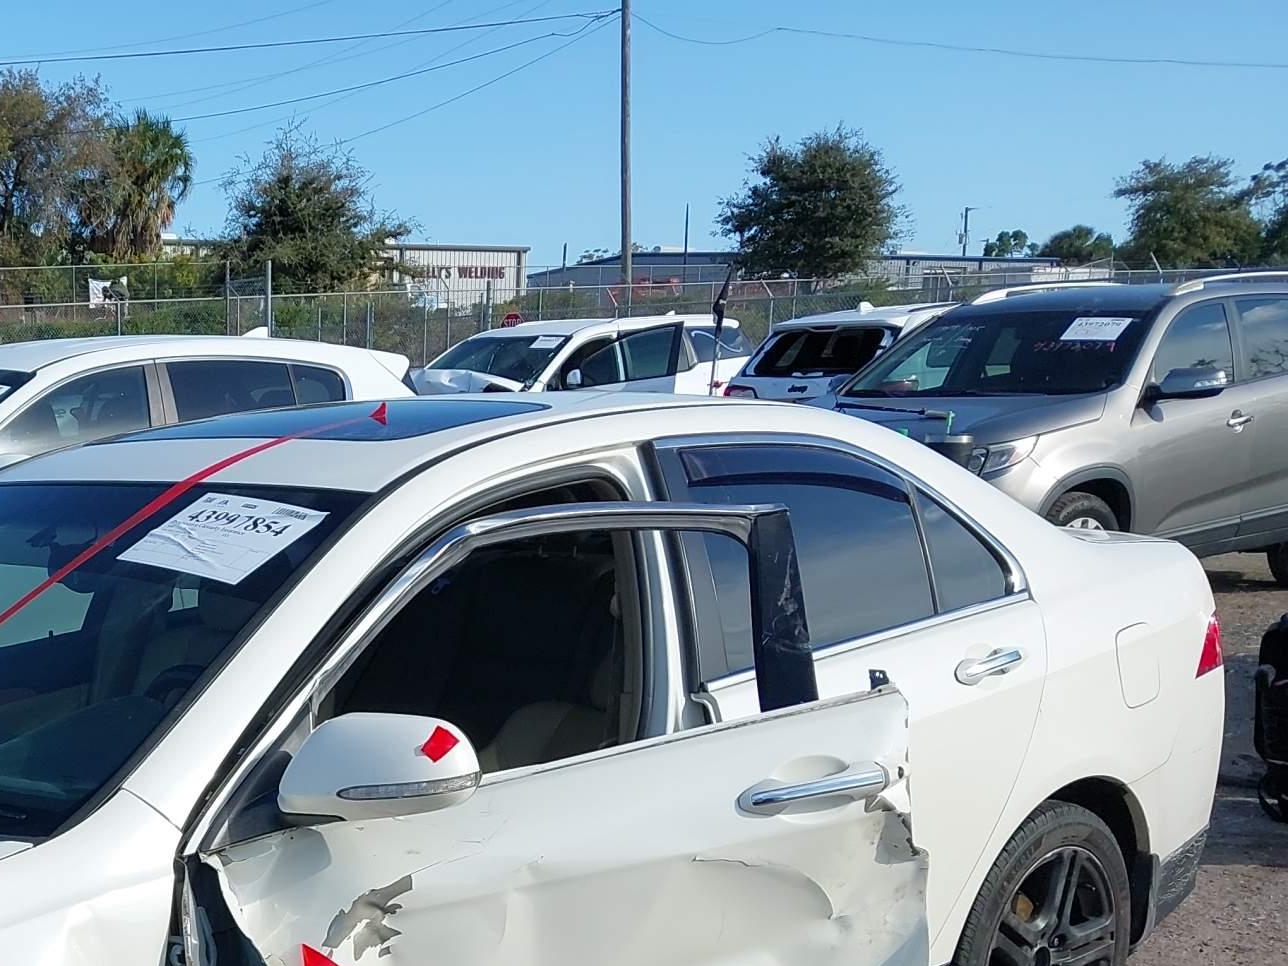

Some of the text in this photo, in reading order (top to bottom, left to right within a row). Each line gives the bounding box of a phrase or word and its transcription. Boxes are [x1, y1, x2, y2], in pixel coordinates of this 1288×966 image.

[420, 266, 505, 279] ELLY'S WELDING
[503, 318, 522, 328] STOP
[188, 509, 292, 537] 43997854
